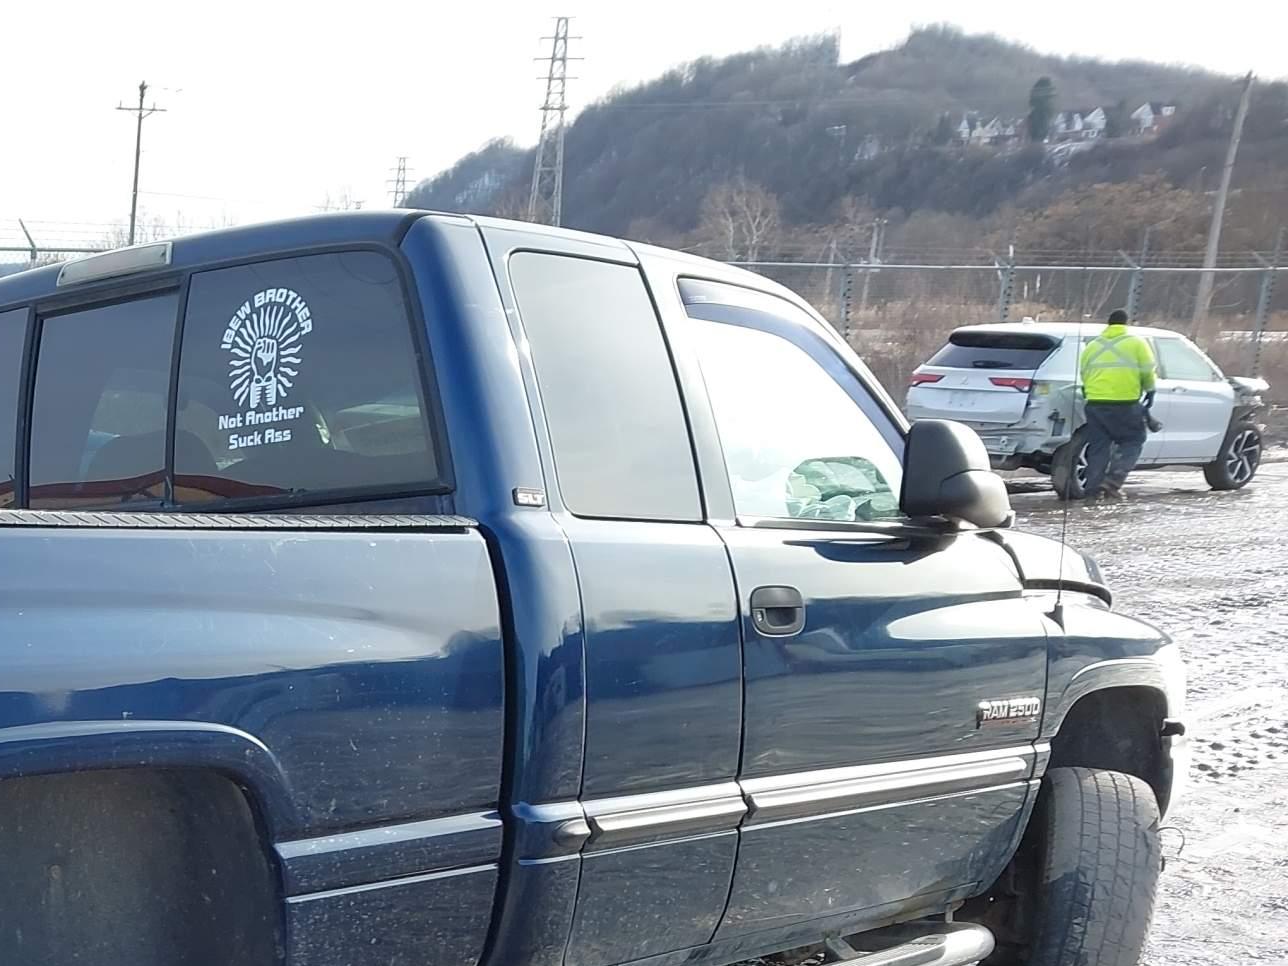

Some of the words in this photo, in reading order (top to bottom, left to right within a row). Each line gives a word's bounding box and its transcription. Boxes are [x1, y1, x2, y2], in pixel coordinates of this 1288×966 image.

[221, 301, 251, 349] IBEW
[254, 288, 313, 335] BROTHER
[218, 413, 243, 430] Not
[246, 406, 304, 426] Another
[229, 431, 262, 450] Suck
[264, 429, 291, 444] Ass
[979, 701, 1009, 720] RAM
[1009, 698, 1041, 717] 2500
